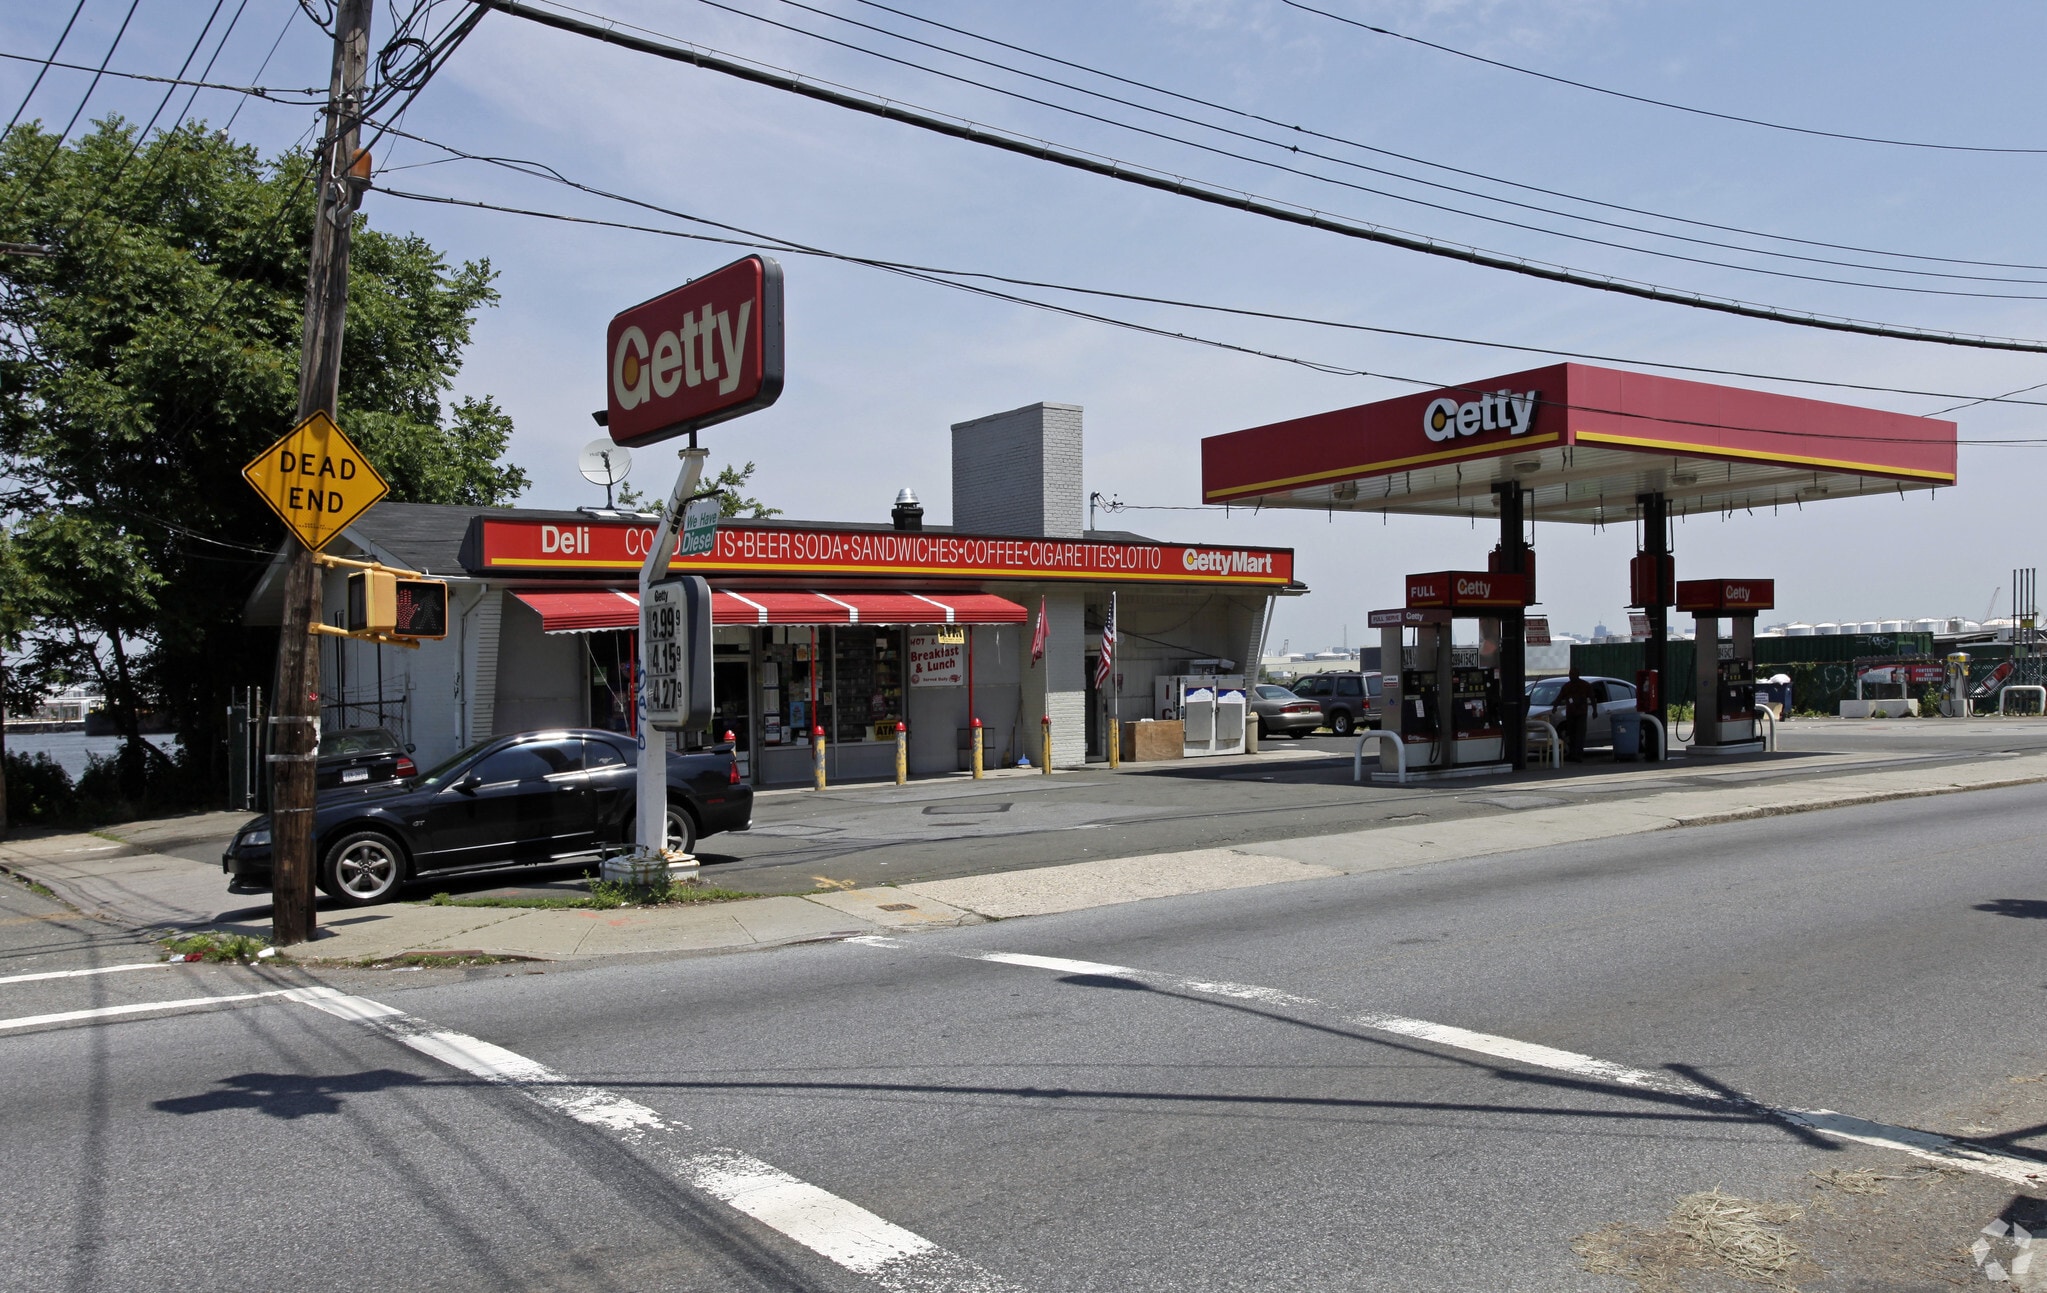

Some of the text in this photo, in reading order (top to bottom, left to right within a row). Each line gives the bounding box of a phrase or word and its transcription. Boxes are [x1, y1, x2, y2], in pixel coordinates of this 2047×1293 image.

[613, 300, 752, 410] Getty
[1423, 389, 1539, 442] Getty
[280, 451, 356, 480] DEAD
[289, 487, 344, 513] END
[687, 513, 717, 528] We Have
[541, 525, 590, 554] Deli
[682, 528, 716, 553] Diesel
[744, 532, 791, 559] BEER
[794, 533, 843, 560] SODA
[851, 535, 959, 563] SANDWICHES
[964, 539, 1024, 565] COFFEE
[1029, 542, 1116, 568] CIGARETTES
[1120, 546, 1162, 570] LOTTO
[1182, 548, 1273, 575] GettyMart
[654, 590, 669, 603] Getty
[1411, 586, 1436, 598] FULL
[1457, 578, 1491, 598] Getty
[1726, 585, 1750, 602] Getty
[653, 607, 675, 638] 3.99
[1406, 612, 1424, 621] Getty
[910, 638, 925, 646] HOT
[911, 646, 960, 662] Breakfast
[653, 642, 677, 674] 4.15
[915, 658, 956, 673] & Lunch
[653, 678, 677, 709] 4.27
